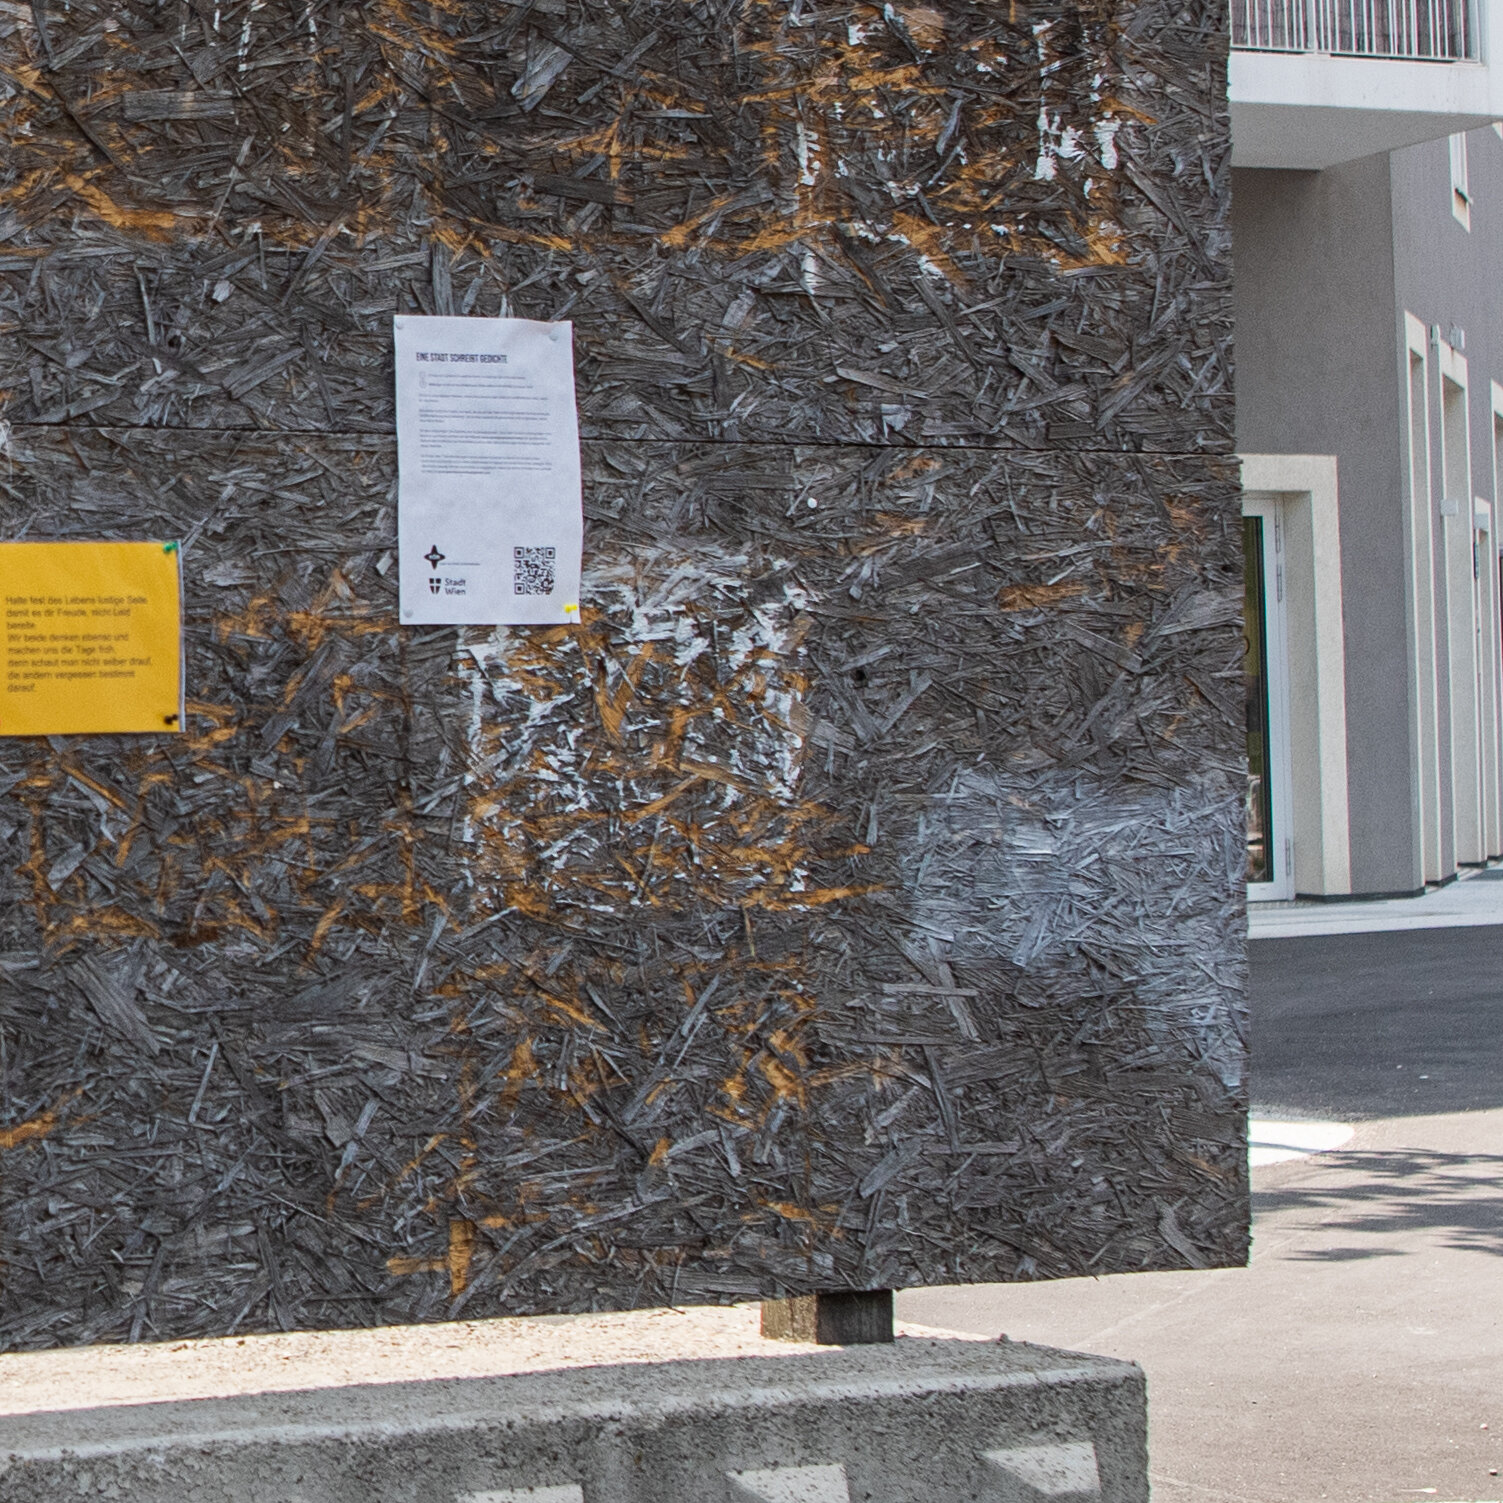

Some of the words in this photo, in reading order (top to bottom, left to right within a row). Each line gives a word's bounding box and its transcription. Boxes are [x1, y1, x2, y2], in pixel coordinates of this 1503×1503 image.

[416, 352, 430, 362] EINE
[431, 353, 449, 362] STADT
[445, 578, 466, 586] Stadt
